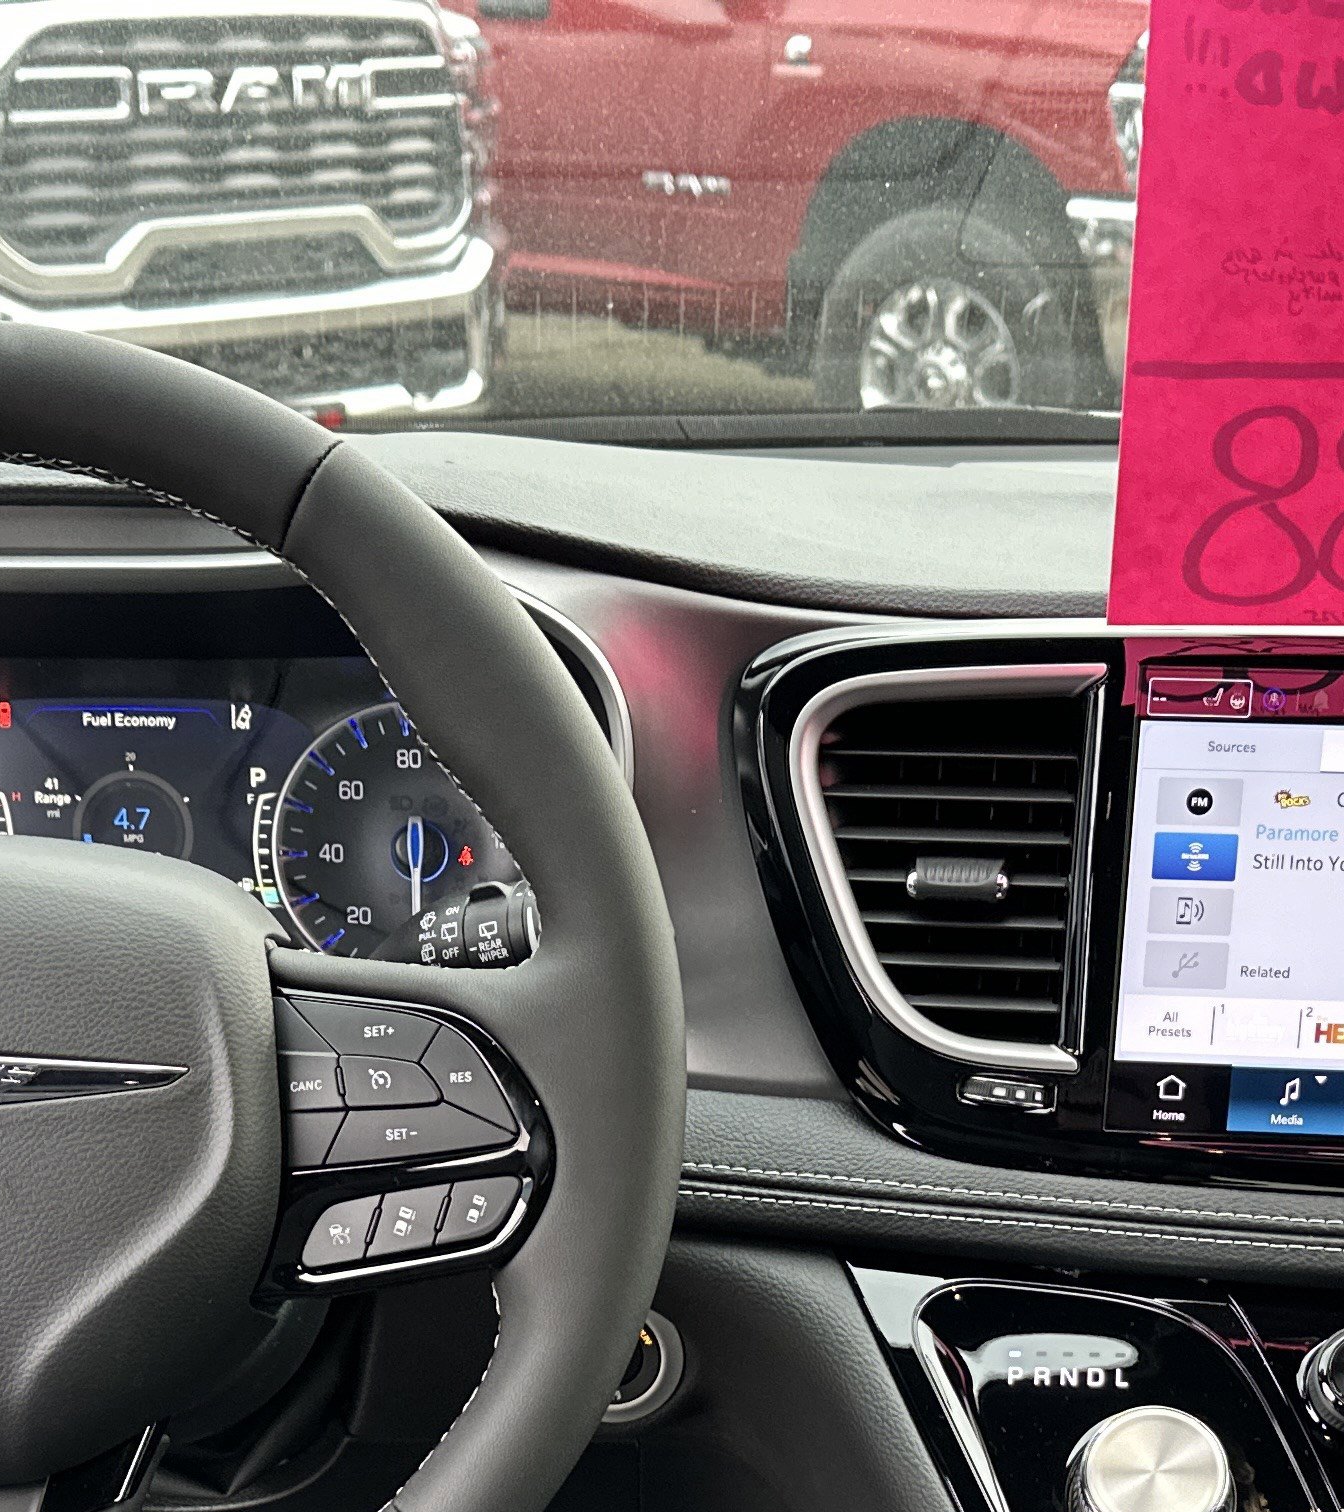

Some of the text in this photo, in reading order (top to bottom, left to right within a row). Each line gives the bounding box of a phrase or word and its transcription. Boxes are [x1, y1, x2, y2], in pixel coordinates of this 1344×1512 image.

[137, 64, 372, 116] RAM
[82, 713, 176, 730] Fuel Economy
[1207, 740, 1257, 754] Sources
[396, 749, 421, 769] 80
[250, 767, 267, 788] P
[11, 791, 22, 802] H
[338, 780, 364, 800] 60
[34, 790, 72, 807] Range
[246, 793, 255, 805] F
[1190, 796, 1209, 808] FM
[113, 806, 151, 831] 4.7
[123, 832, 145, 844] MPG
[1255, 824, 1339, 843] Paramore
[319, 843, 344, 863] 40
[1252, 853, 1285, 871] Still
[1289, 854, 1324, 872] Into
[347, 906, 372, 925] 20
[478, 938, 503, 952] REAR
[442, 946, 460, 960] OFF
[478, 947, 509, 963] WIPER
[1239, 965, 1292, 980] Related
[1162, 1011, 1179, 1023] All
[1305, 1006, 1314, 1019] 2
[1148, 1025, 1192, 1039] Presets
[449, 1071, 473, 1084] RES
[290, 1079, 323, 1093] CANC
[1152, 1110, 1186, 1122] Home
[1270, 1114, 1304, 1126] Media
